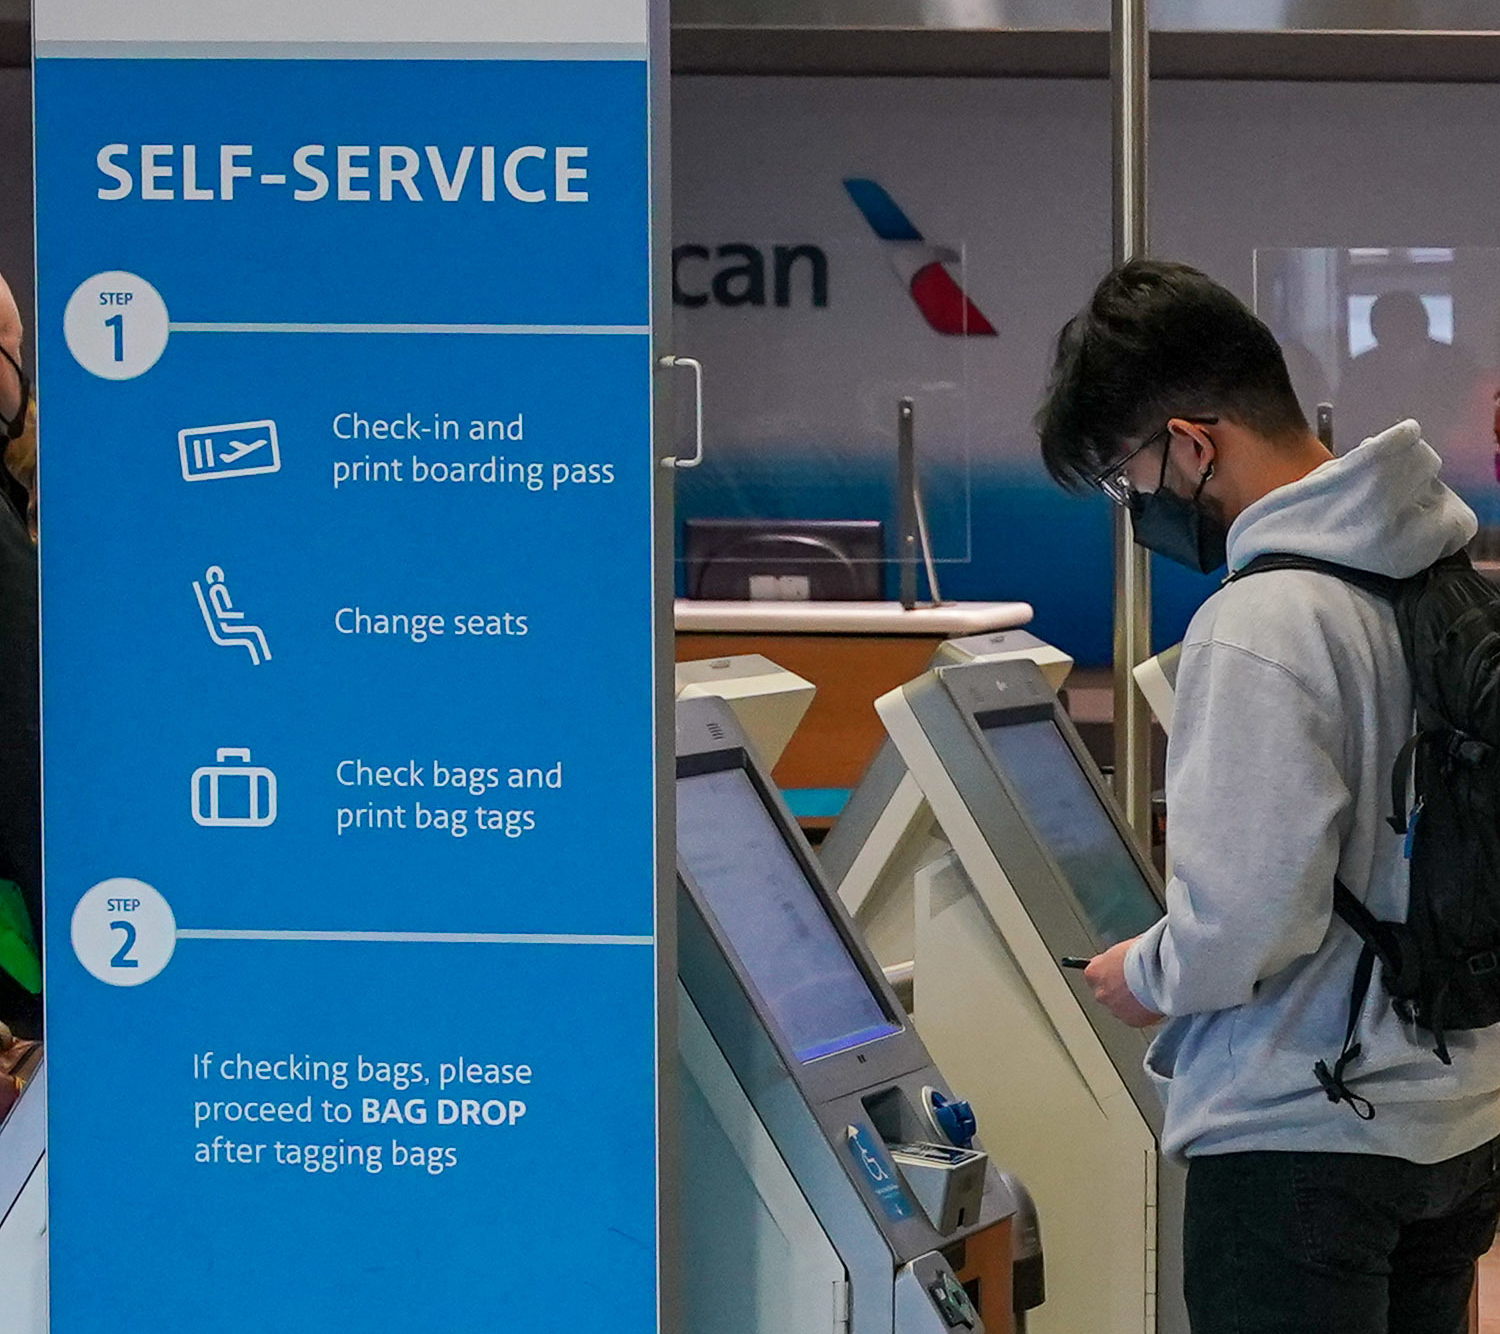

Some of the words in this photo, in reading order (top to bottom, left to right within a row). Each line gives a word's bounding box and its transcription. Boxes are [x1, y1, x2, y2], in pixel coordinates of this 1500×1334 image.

[96, 143, 588, 203] SELF-SERVICE
[99, 291, 133, 305] STEP
[104, 314, 123, 362] 1
[332, 412, 459, 440] Check-in
[469, 413, 523, 440] and
[333, 454, 403, 489] print
[412, 455, 543, 491] boarding
[552, 463, 614, 491] pass
[335, 607, 444, 643] Change
[453, 612, 528, 635] seats
[336, 759, 424, 786] Check
[433, 759, 498, 796] bags
[507, 761, 561, 788] and
[337, 801, 406, 835] print
[415, 801, 468, 837] bag
[474, 806, 535, 838] tags
[107, 898, 141, 912] STEP
[109, 920, 138, 968] 2
[194, 1051, 213, 1079] If
[220, 1052, 348, 1089] checking
[357, 1054, 429, 1090] bags,
[439, 1056, 532, 1090] please
[194, 1095, 312, 1128] proceed
[321, 1100, 352, 1123] to
[362, 1097, 427, 1124] BAG
[437, 1098, 526, 1125] DROP
[194, 1135, 267, 1163] after
[273, 1138, 382, 1173] tagging
[392, 1139, 457, 1175] bags
